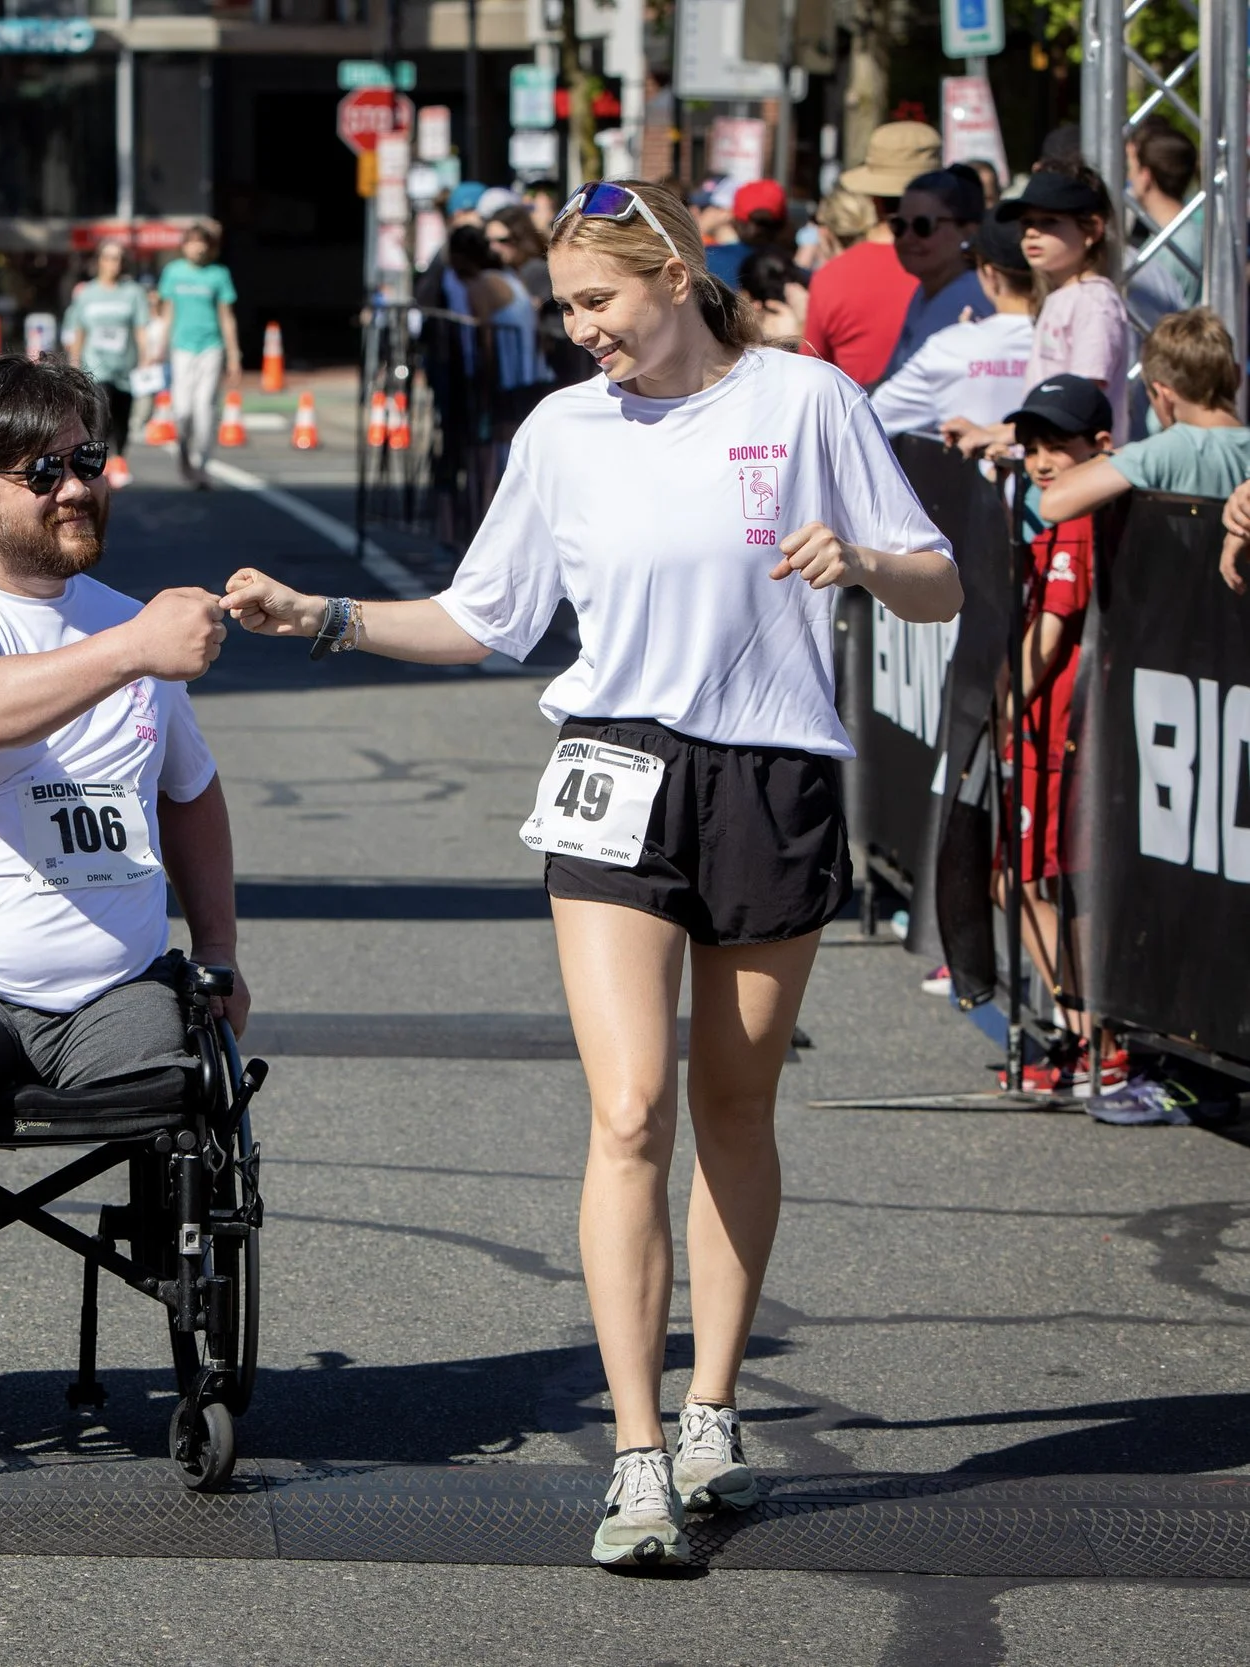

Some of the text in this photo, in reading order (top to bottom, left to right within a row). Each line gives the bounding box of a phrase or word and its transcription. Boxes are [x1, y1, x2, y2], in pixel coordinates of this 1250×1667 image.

[729, 444, 788, 460] BIONIC 5K
[746, 528, 776, 546] 2026
[135, 725, 158, 743] 2026
[557, 743, 634, 769] BIONIC
[632, 763, 649, 774] 1Mi
[31, 782, 112, 800] BIONIC
[554, 768, 614, 822] 49
[50, 806, 127, 854] 106
[525, 835, 631, 860] FOOD DRINK DRINK
[42, 868, 154, 887] FOOD DRINK DRINK
